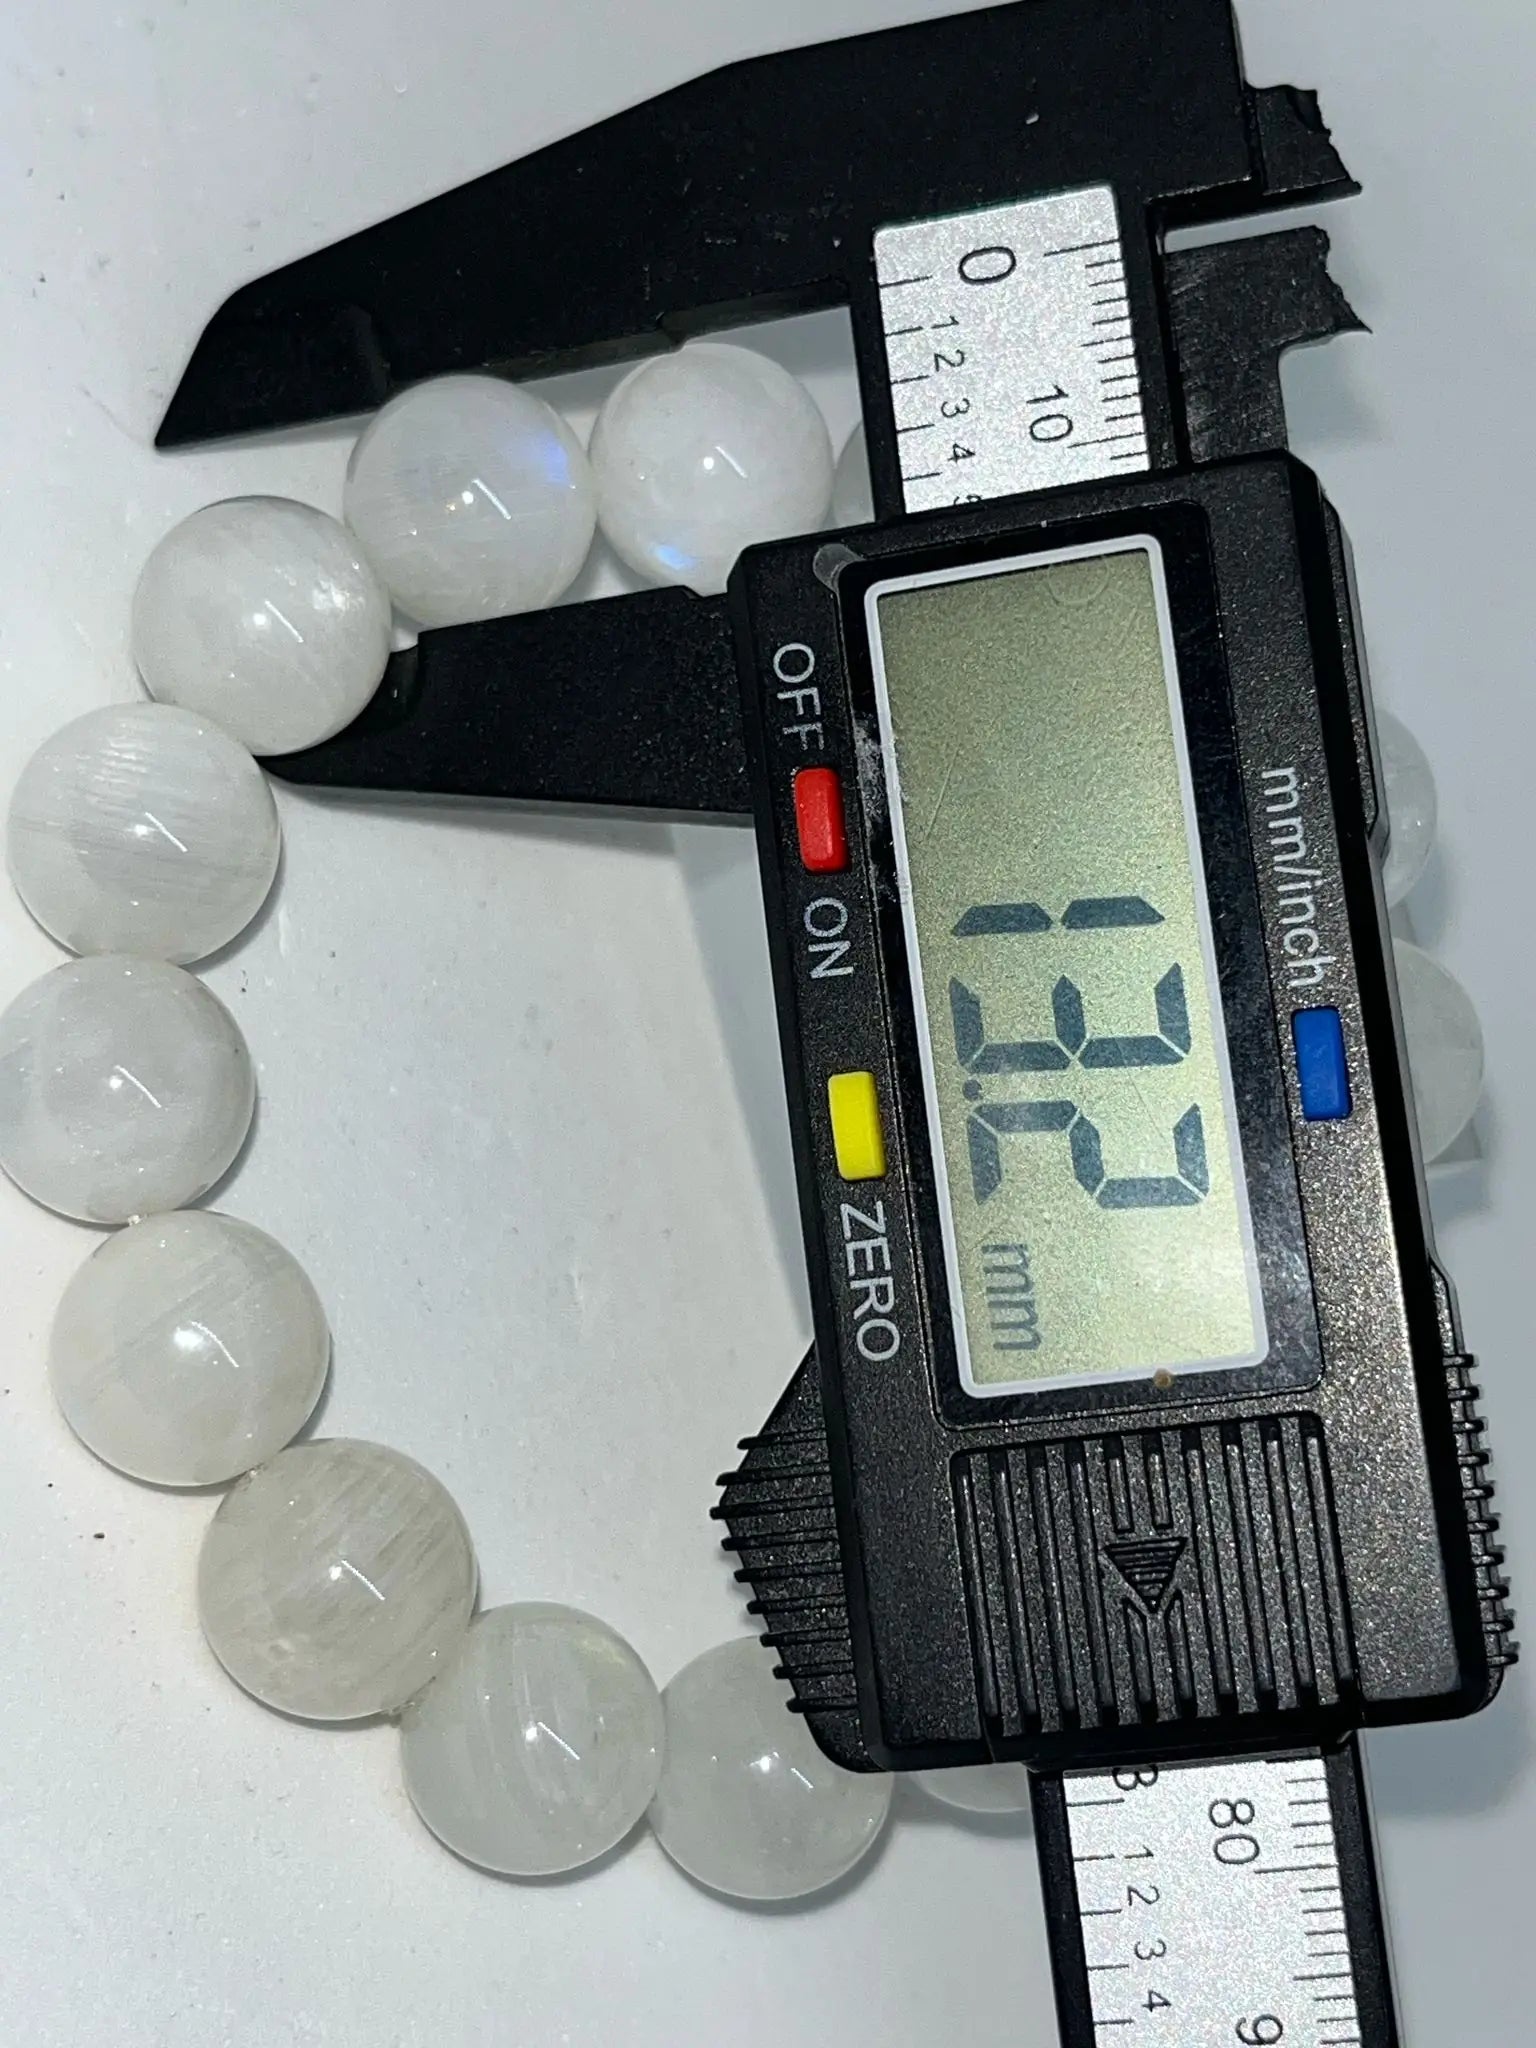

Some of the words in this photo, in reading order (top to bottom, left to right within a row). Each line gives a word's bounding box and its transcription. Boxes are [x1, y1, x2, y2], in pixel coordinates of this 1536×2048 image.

[958, 246, 1017, 286] 0
[930, 315, 960, 330] 1
[933, 349, 966, 373] 2
[940, 397, 971, 419] 3
[1026, 384, 1074, 443] 10
[947, 442, 976, 464] 4
[773, 642, 825, 751] OFF
[1261, 766, 1337, 988] mm/inch
[803, 897, 854, 979] ON
[950, 896, 1210, 1209] 13.2
[839, 1199, 900, 1362] ZERO
[981, 1243, 1042, 1351] mm
[1208, 1797, 1260, 1865] 80
[1123, 1844, 1155, 1859] 1
[1126, 1884, 1161, 1907] 2
[1133, 1938, 1167, 1961] 3
[1141, 1989, 1173, 2013] 4
